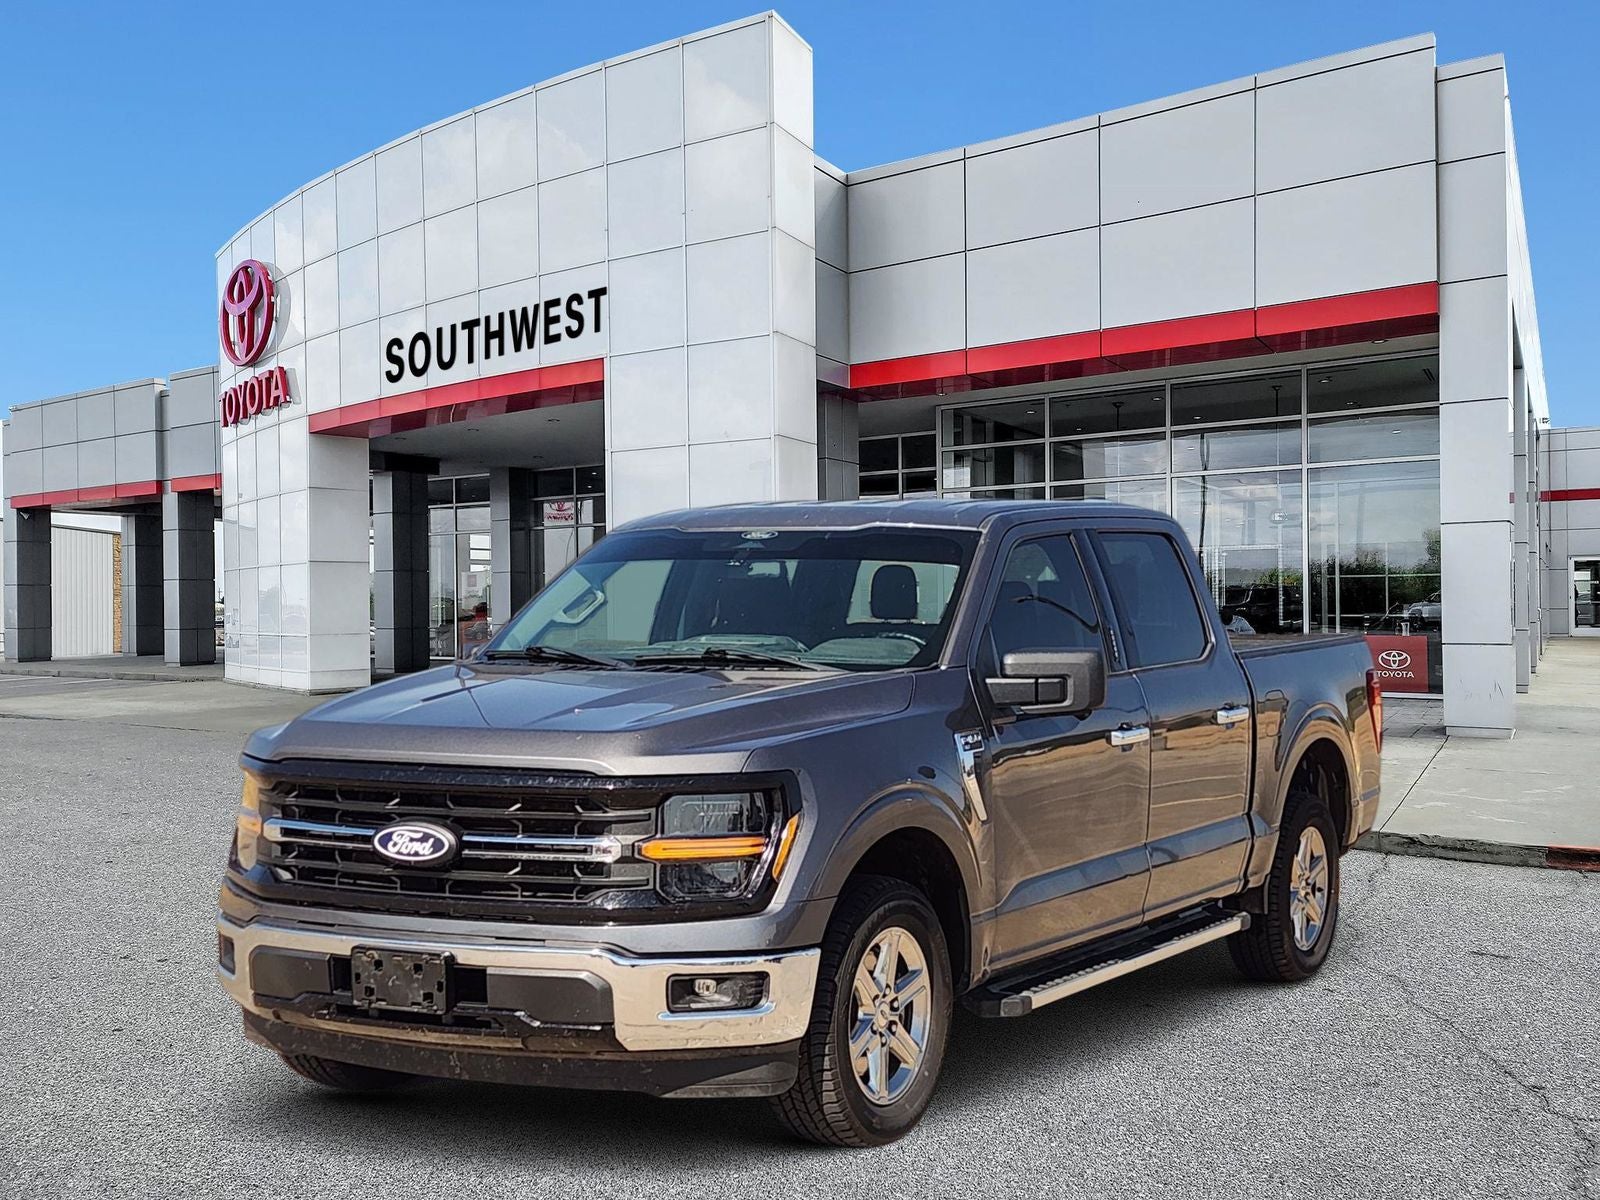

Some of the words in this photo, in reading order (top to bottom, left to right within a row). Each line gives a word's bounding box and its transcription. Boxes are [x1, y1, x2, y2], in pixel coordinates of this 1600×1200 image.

[385, 286, 608, 384] SOUTHWEST
[218, 366, 290, 428] TOYOTA
[1377, 670, 1414, 678] TOYOTA
[387, 830, 435, 855] Ford
